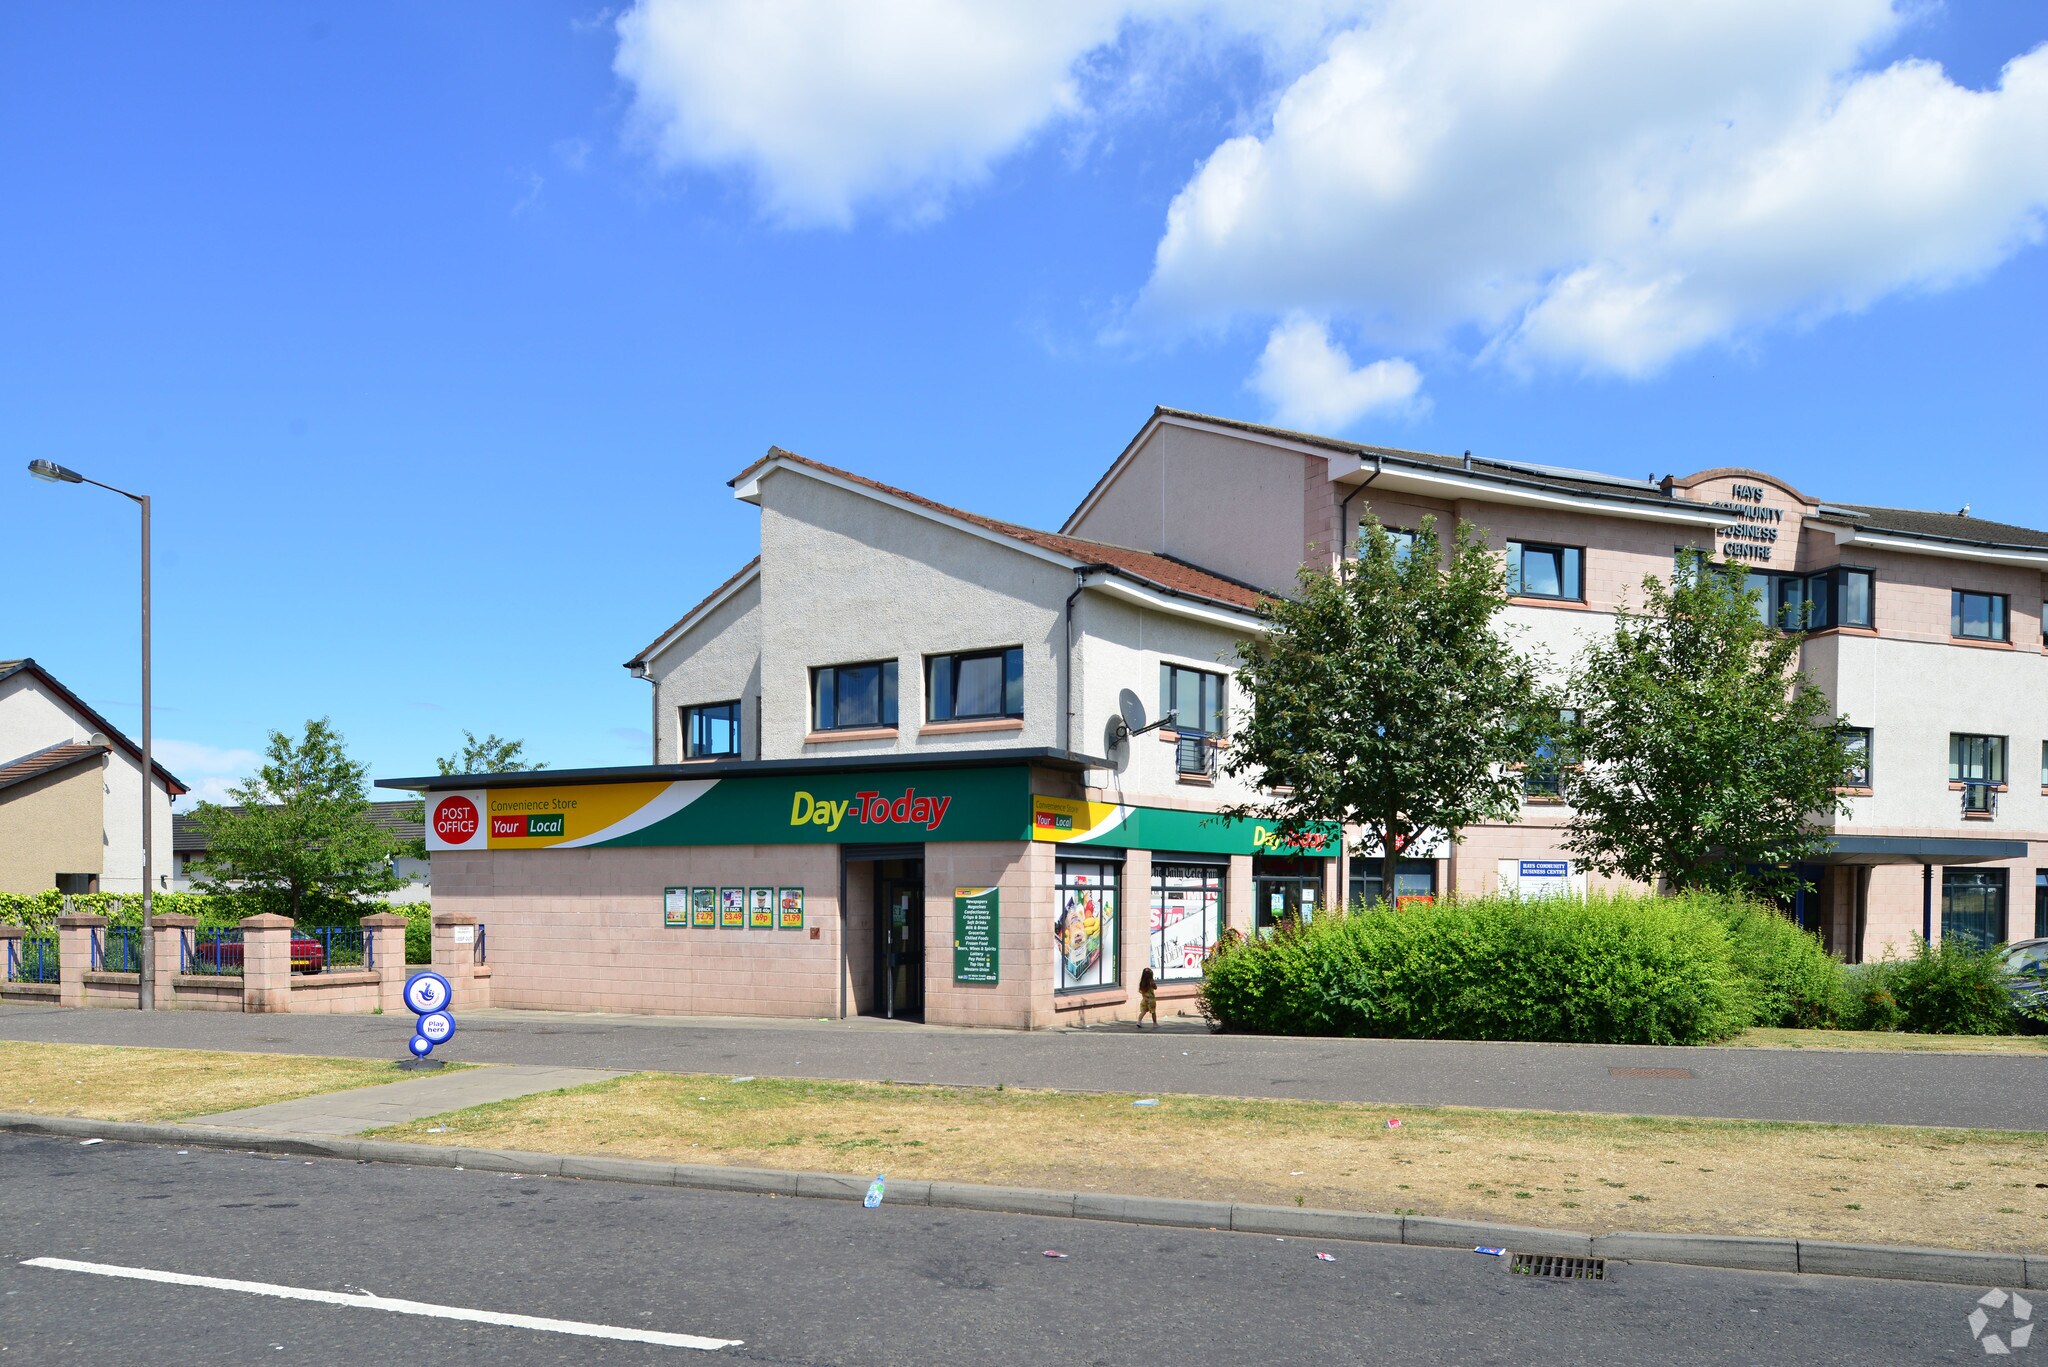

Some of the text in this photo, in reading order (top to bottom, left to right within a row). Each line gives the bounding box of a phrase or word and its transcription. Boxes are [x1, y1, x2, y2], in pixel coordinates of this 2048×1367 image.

[1732, 484, 1764, 500] HAYS
[1724, 542, 1772, 558] CENTRE
[491, 798, 578, 812] Convenience Store
[790, 788, 952, 832] Day-Today
[1036, 800, 1079, 813] Convenience Store
[442, 807, 470, 820] POST
[1037, 814, 1072, 827] Your Local
[438, 820, 474, 834] OFFICE
[493, 819, 562, 834] Your Local
[756, 914, 768, 922] 69p
